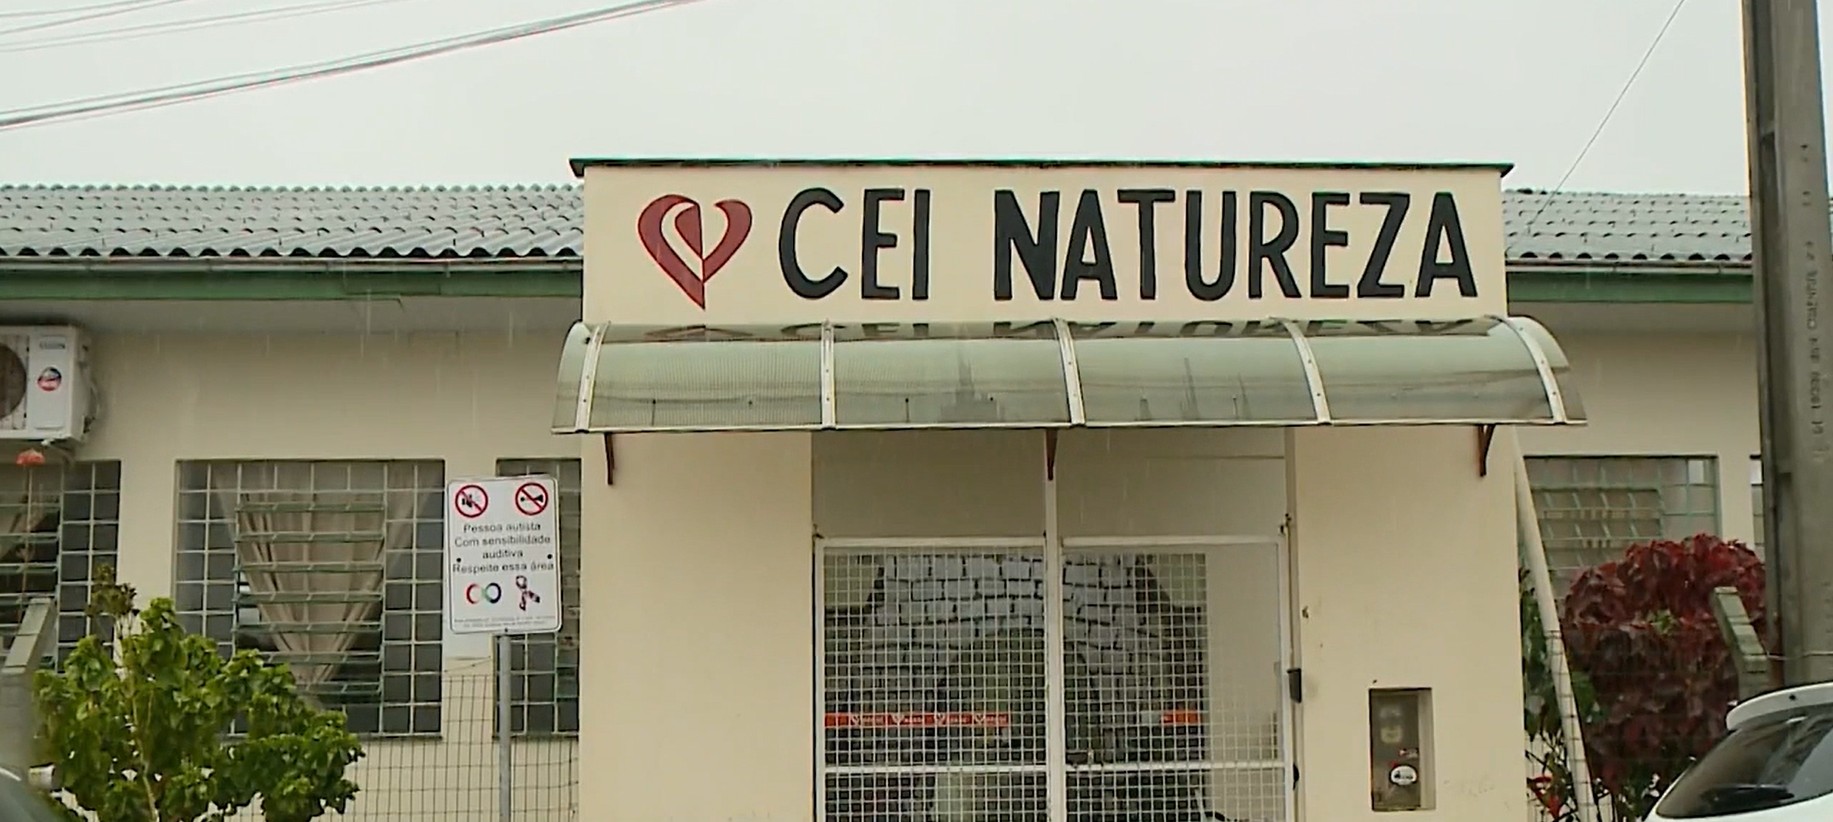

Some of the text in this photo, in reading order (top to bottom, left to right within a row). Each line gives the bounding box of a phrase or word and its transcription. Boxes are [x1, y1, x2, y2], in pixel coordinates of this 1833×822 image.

[778, 187, 1479, 303] CEI NATUREZA
[463, 521, 541, 533] Pessoa autista
[454, 534, 551, 548] Com sensibilidade
[483, 549, 523, 559] auditiva
[452, 561, 554, 575] Respeite essa área
